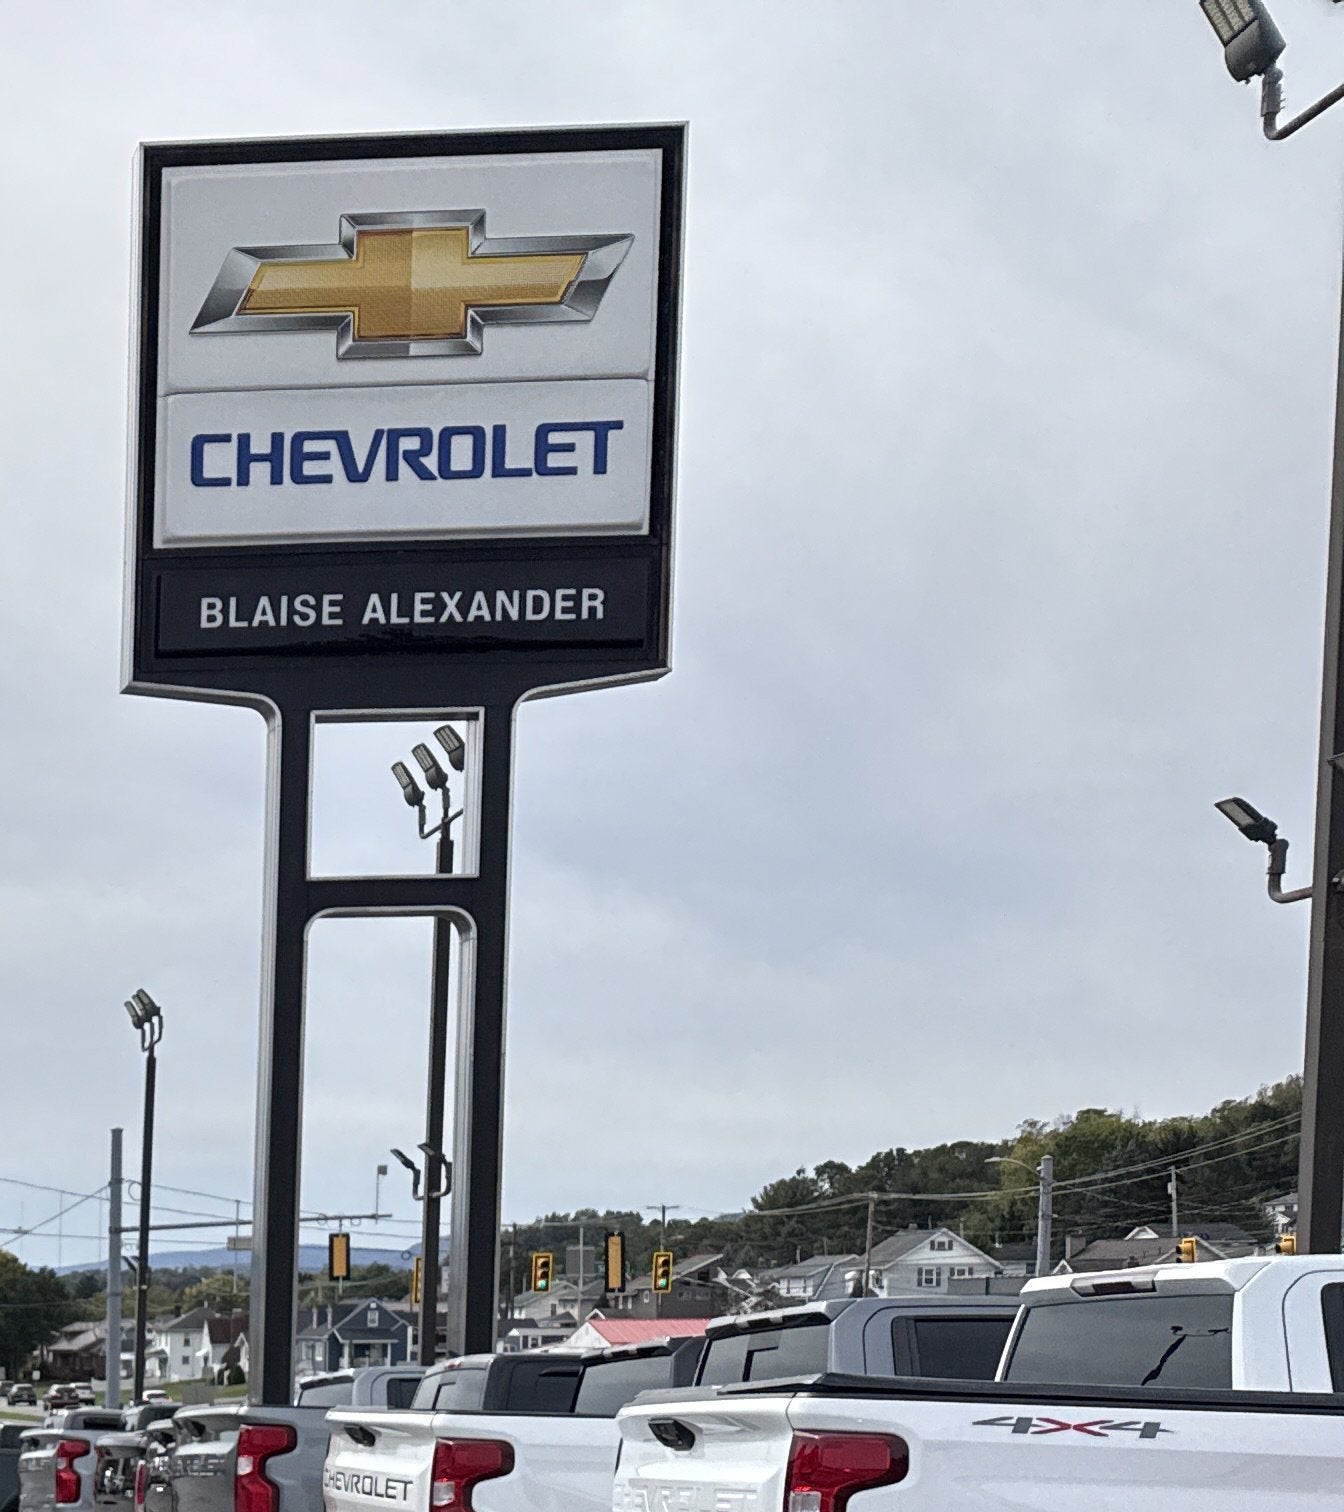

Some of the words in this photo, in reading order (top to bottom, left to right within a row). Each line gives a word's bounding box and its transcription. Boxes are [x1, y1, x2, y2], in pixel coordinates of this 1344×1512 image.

[190, 420, 624, 488] CHEVROLET
[199, 592, 343, 630] BLAISE
[361, 587, 606, 627] ALEXANDER
